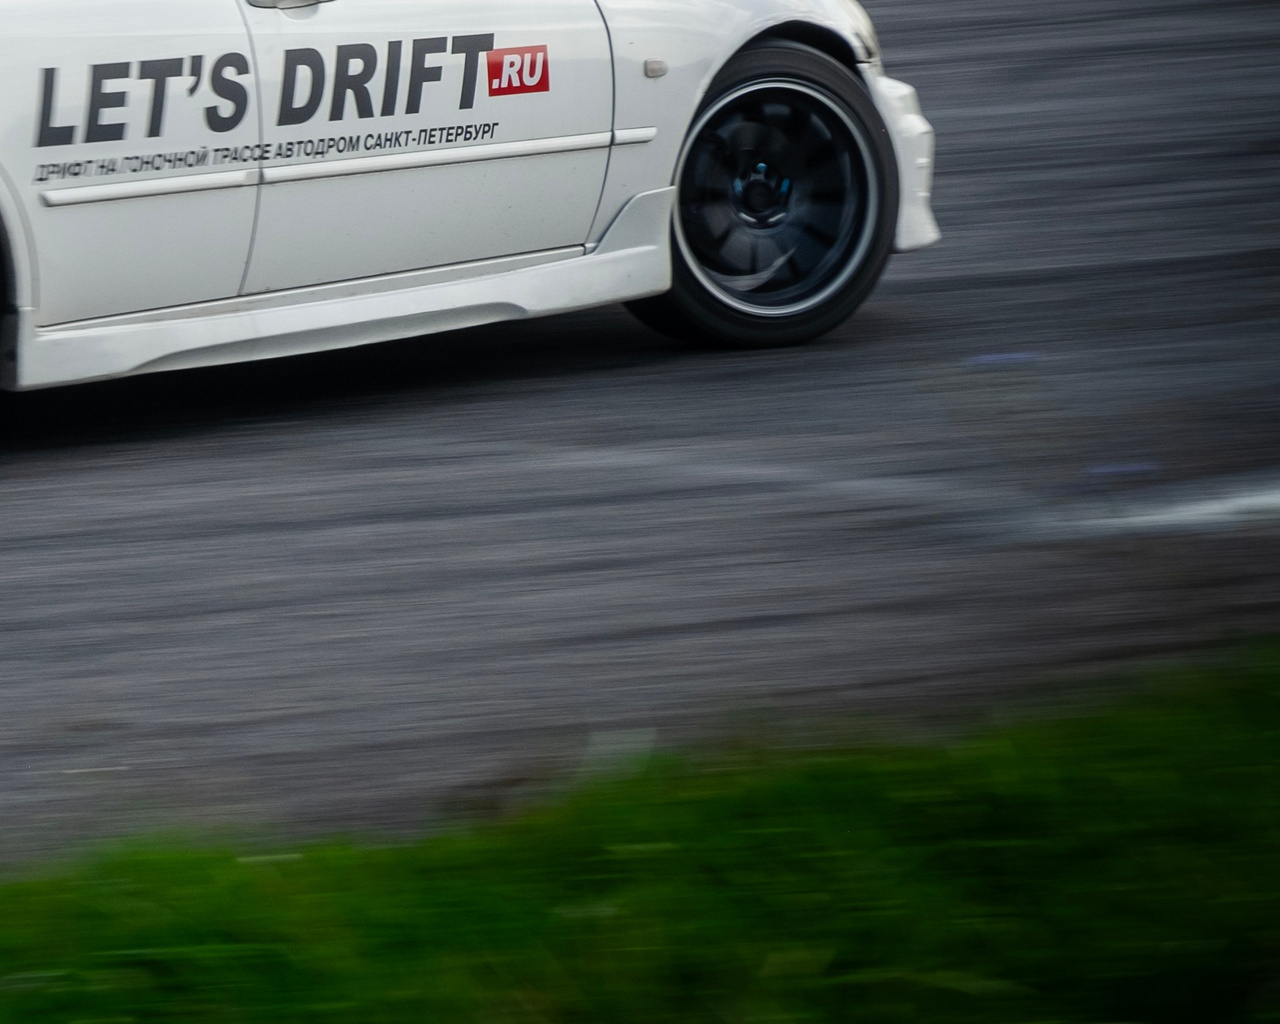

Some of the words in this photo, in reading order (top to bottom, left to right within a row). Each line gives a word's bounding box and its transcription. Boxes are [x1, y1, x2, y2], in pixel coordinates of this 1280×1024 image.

[33, 52, 251, 148] LET'S
[276, 33, 495, 126] DRIFT
[491, 51, 545, 89] .RU
[212, 143, 272, 165] ТРАССЕ
[273, 134, 361, 160] АВТОДРОМ
[363, 122, 499, 151] САНКТ-ПЕТЕРБУРГ
